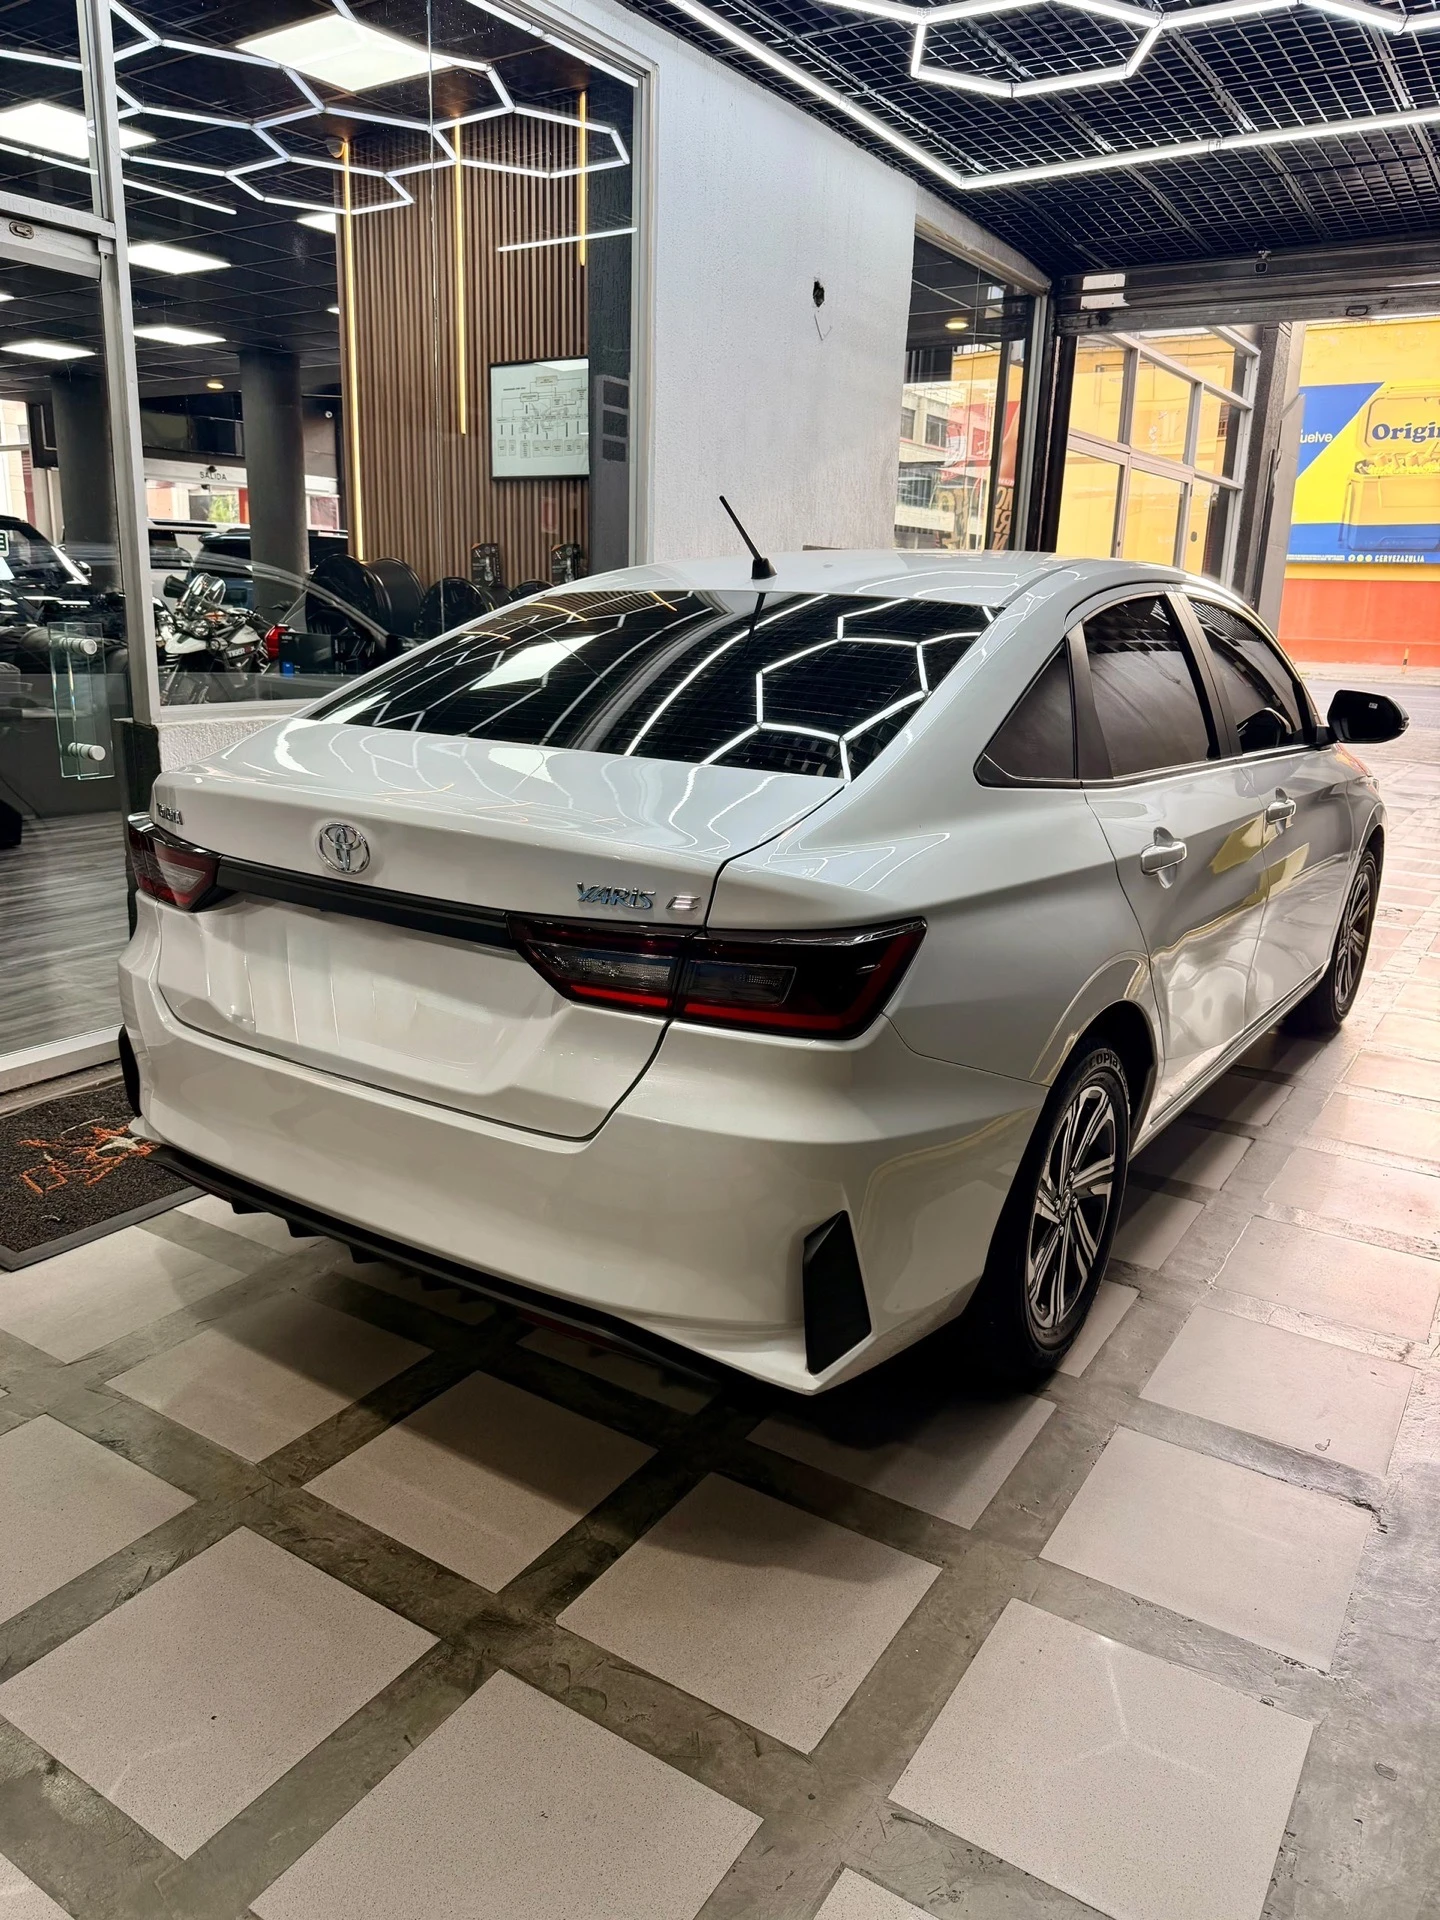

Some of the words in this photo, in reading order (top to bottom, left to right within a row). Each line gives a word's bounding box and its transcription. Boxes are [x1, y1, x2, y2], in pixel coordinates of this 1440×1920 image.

[1300, 428, 1333, 444] uelve
[200, 472, 227, 480] SALIDA
[1375, 555, 1425, 563] CERVEZAZULIA
[227, 647, 246, 658] TIGER
[665, 895, 701, 911] E
